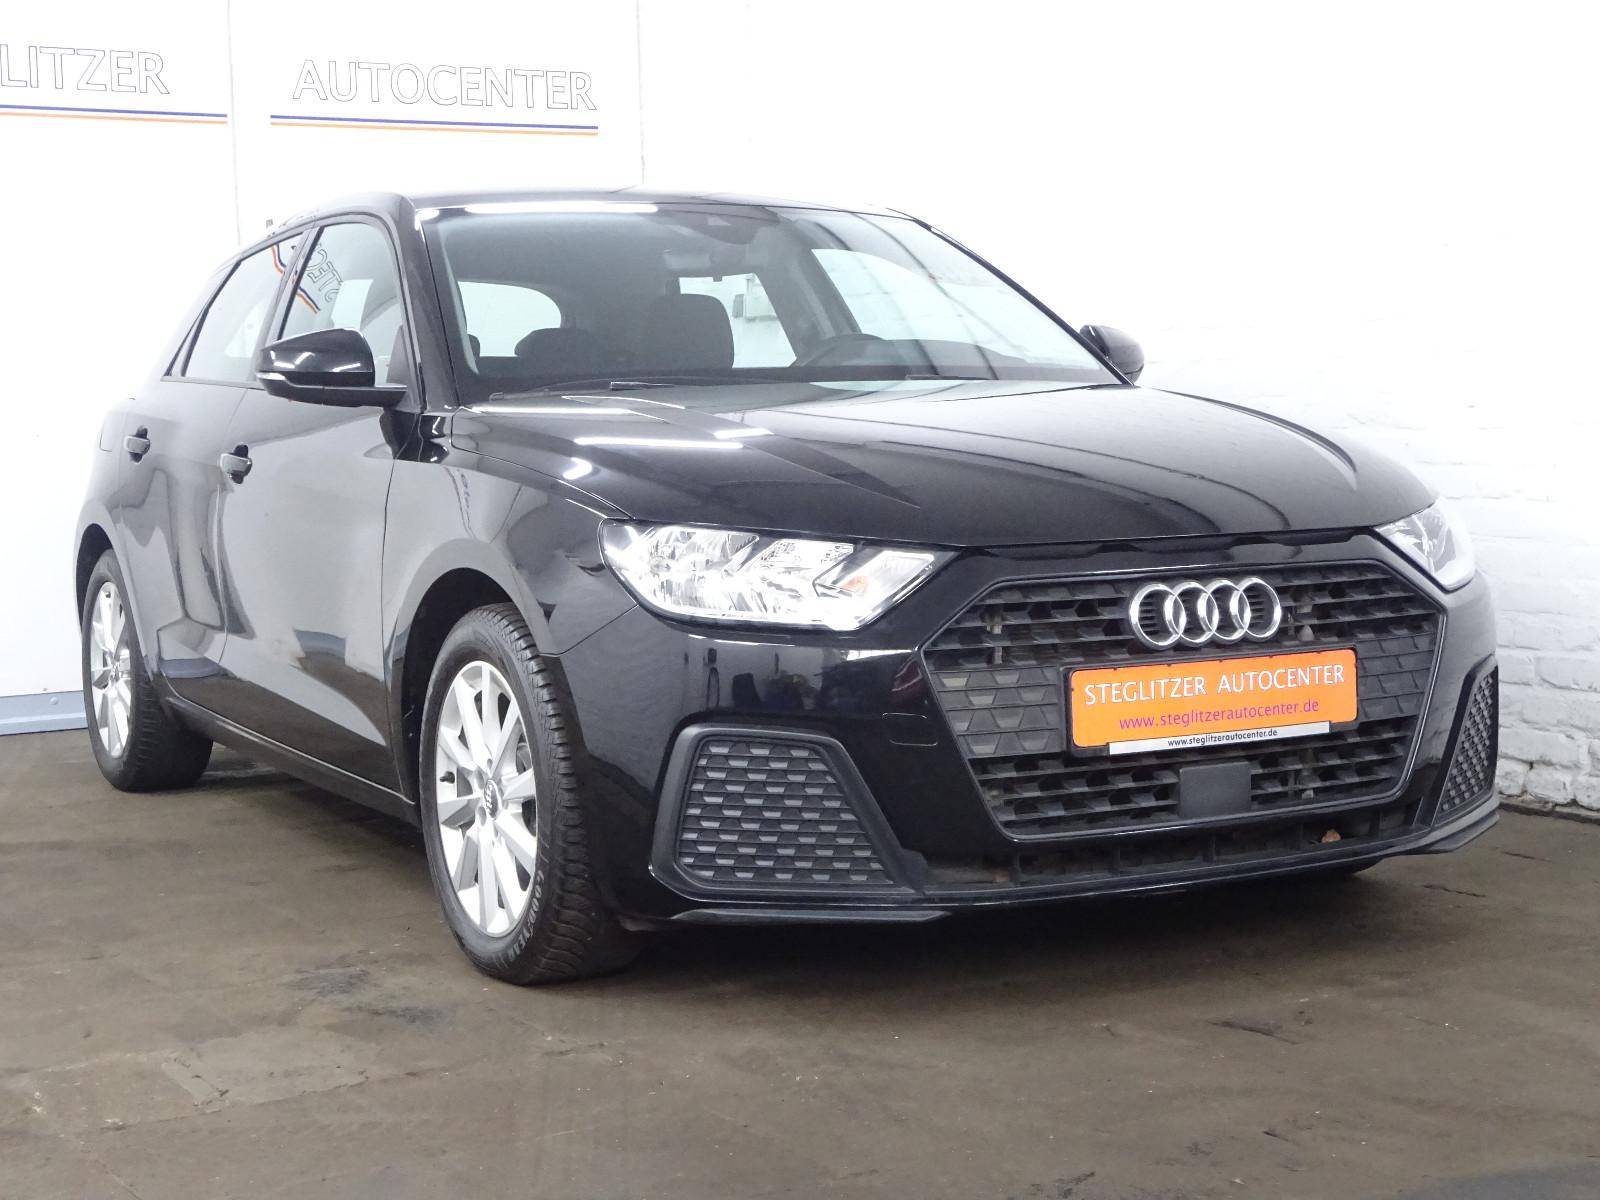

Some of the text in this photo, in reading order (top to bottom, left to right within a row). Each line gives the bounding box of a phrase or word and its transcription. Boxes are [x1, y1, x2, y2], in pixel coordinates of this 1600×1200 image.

[292, 59, 598, 111] AUTOCENTER
[1084, 664, 1345, 706] STEGLITZER AUTOCENTER
[1119, 698, 1319, 730] www.steglitzerautocenter.de
[1167, 728, 1278, 747] www.steglitzerautocenter.de
